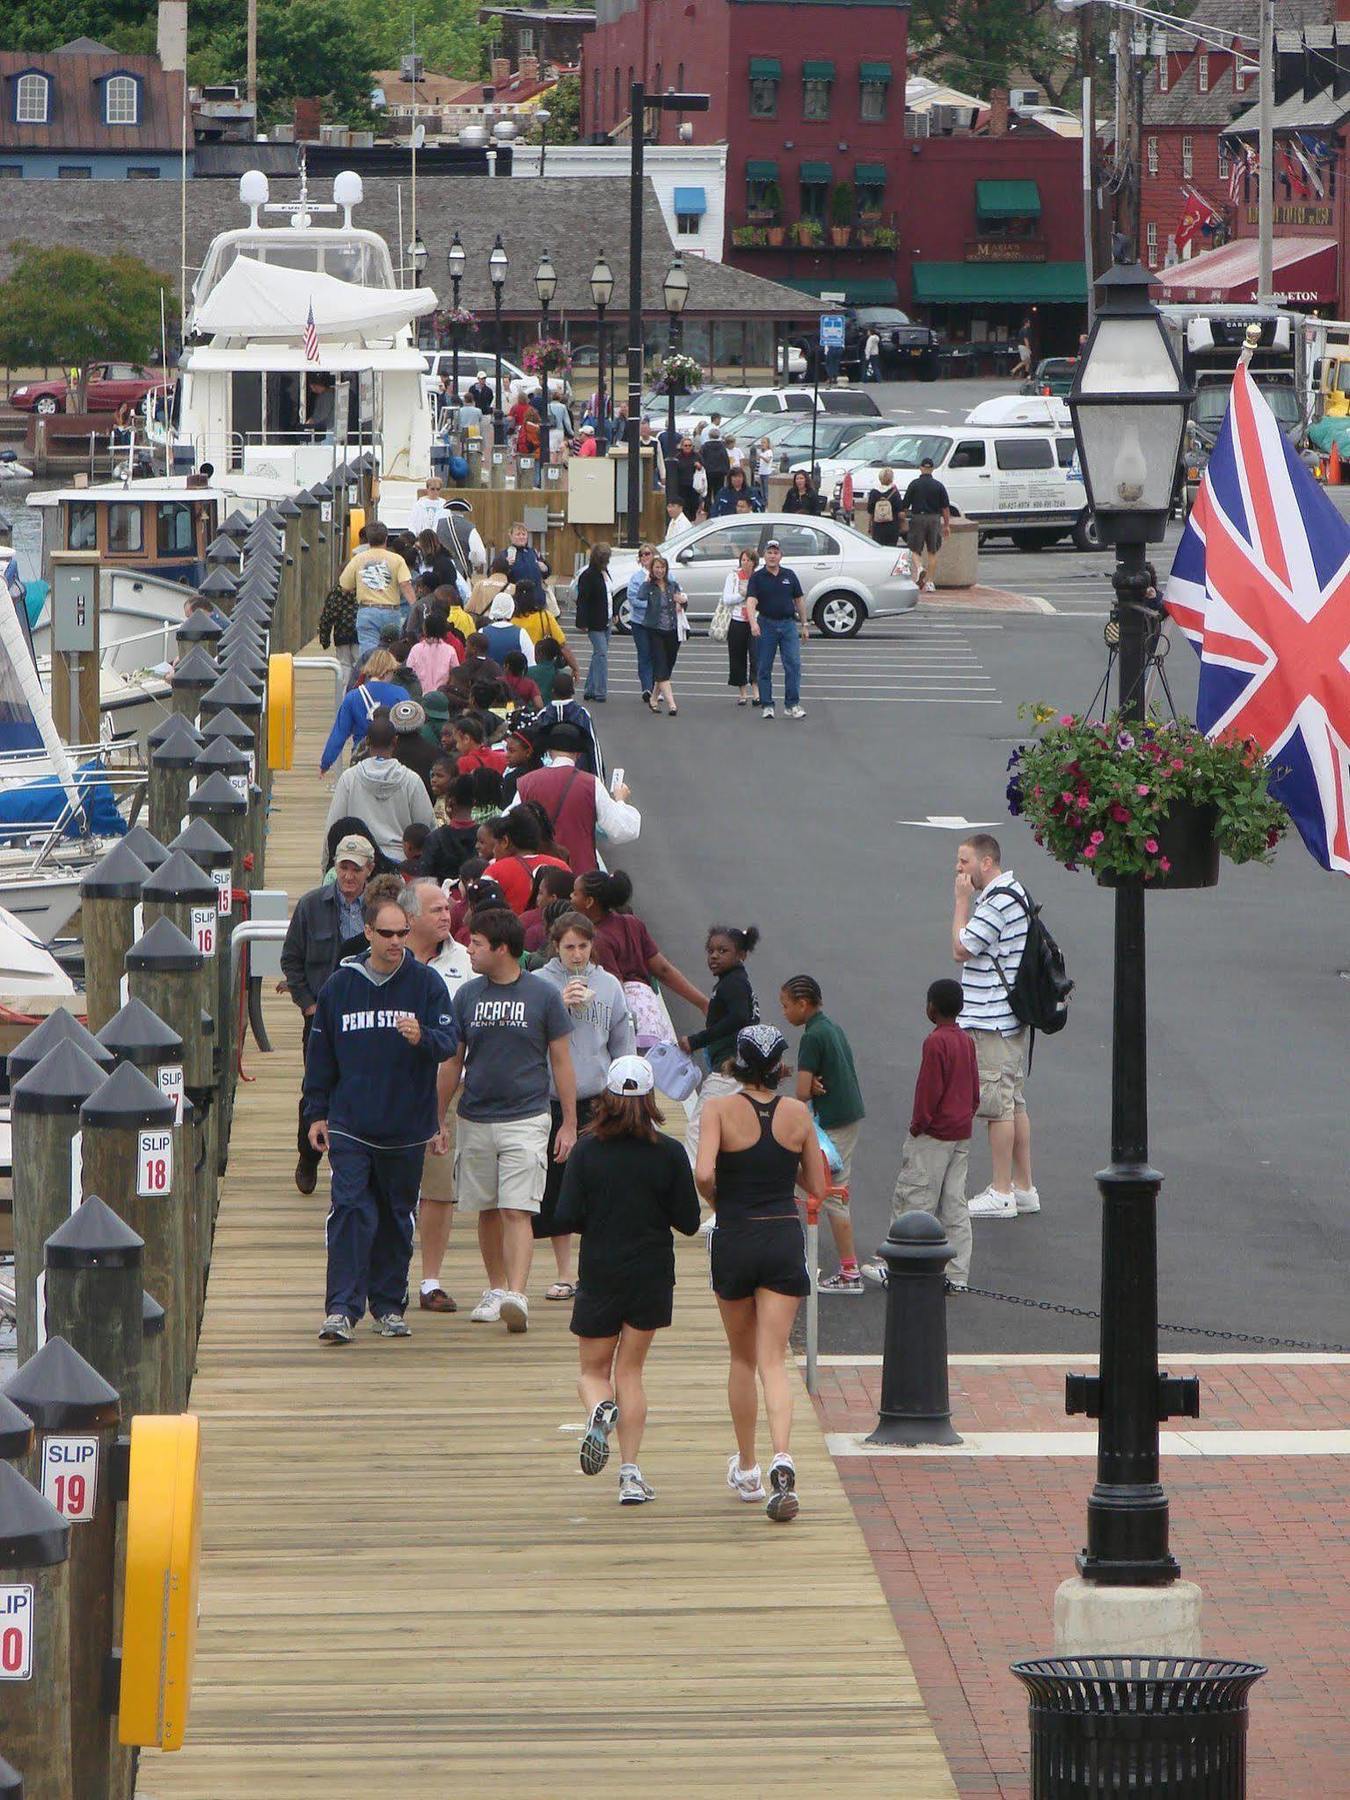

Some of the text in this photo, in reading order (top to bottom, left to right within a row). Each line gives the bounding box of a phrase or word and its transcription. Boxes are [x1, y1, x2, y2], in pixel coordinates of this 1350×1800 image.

[1251, 291, 1318, 300] MDLETON
[213, 873, 230, 885] SLIP
[218, 889, 229, 912] 15
[194, 912, 215, 924] SLIP
[198, 929, 212, 952] 16
[342, 1009, 416, 1032] PENN STA
[474, 1001, 526, 1021] ACACIA
[470, 1020, 529, 1028] PENN STATE
[161, 1072, 182, 1086] SLIP
[142, 1137, 170, 1151] SLIP
[146, 1159, 166, 1190] 18
[48, 1445, 94, 1463] SLIP
[54, 1474, 86, 1514] 19
[0, 1594, 27, 1614] IP
[2, 1626, 23, 1672] 0
